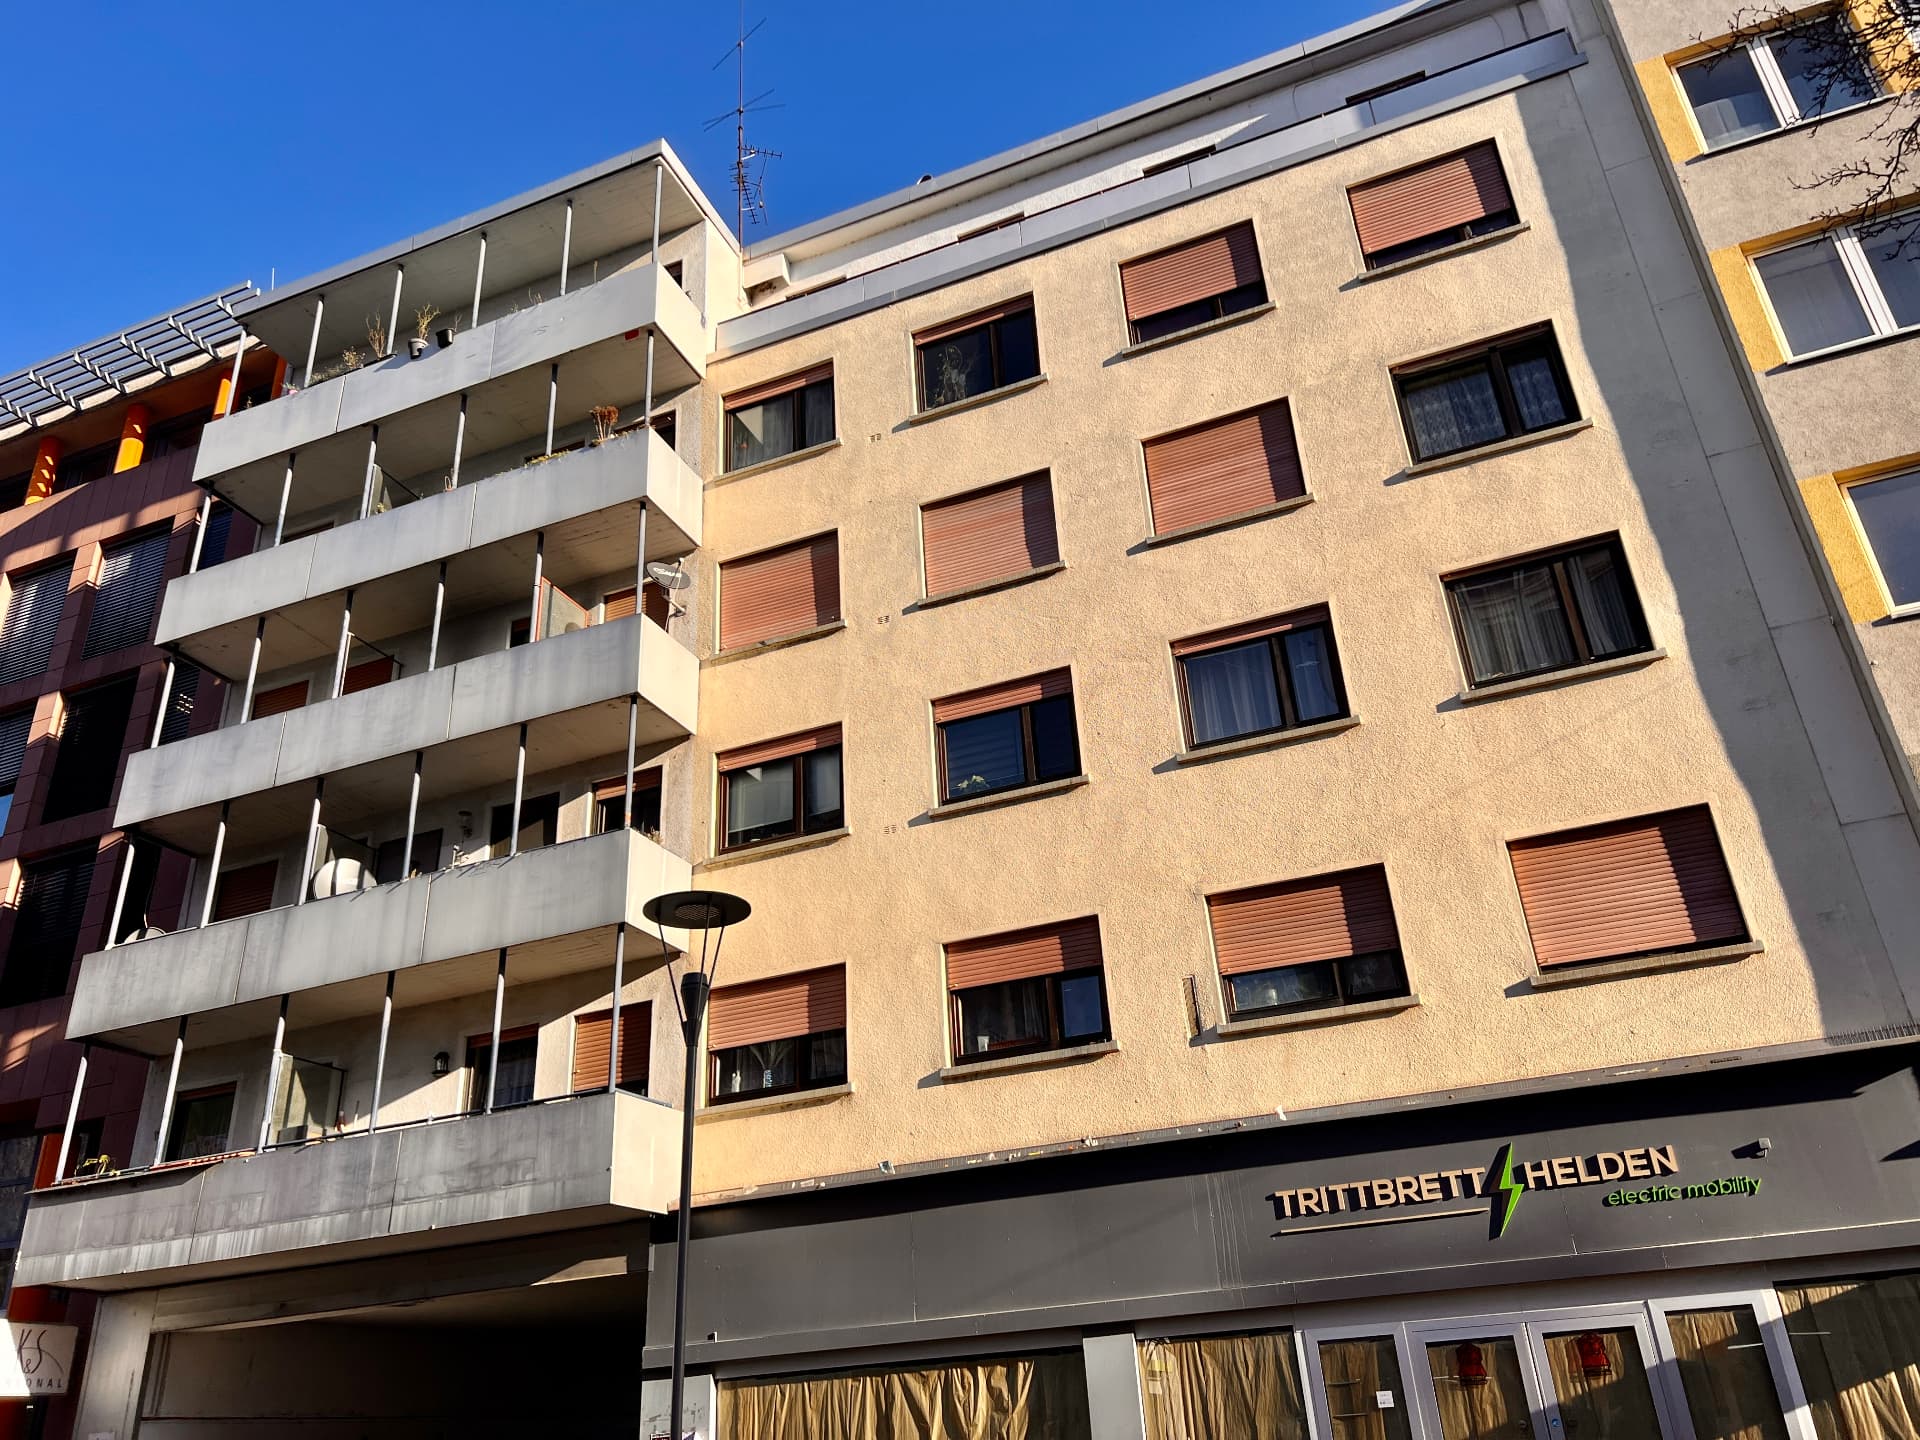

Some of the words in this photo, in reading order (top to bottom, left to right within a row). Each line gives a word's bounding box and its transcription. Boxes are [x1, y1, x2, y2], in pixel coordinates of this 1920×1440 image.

[1275, 1167, 1486, 1217] TRITTBRETT
[1523, 1144, 1680, 1189] HELDEN
[1608, 1184, 1681, 1206] electric
[1687, 1175, 1763, 1200] mobility
